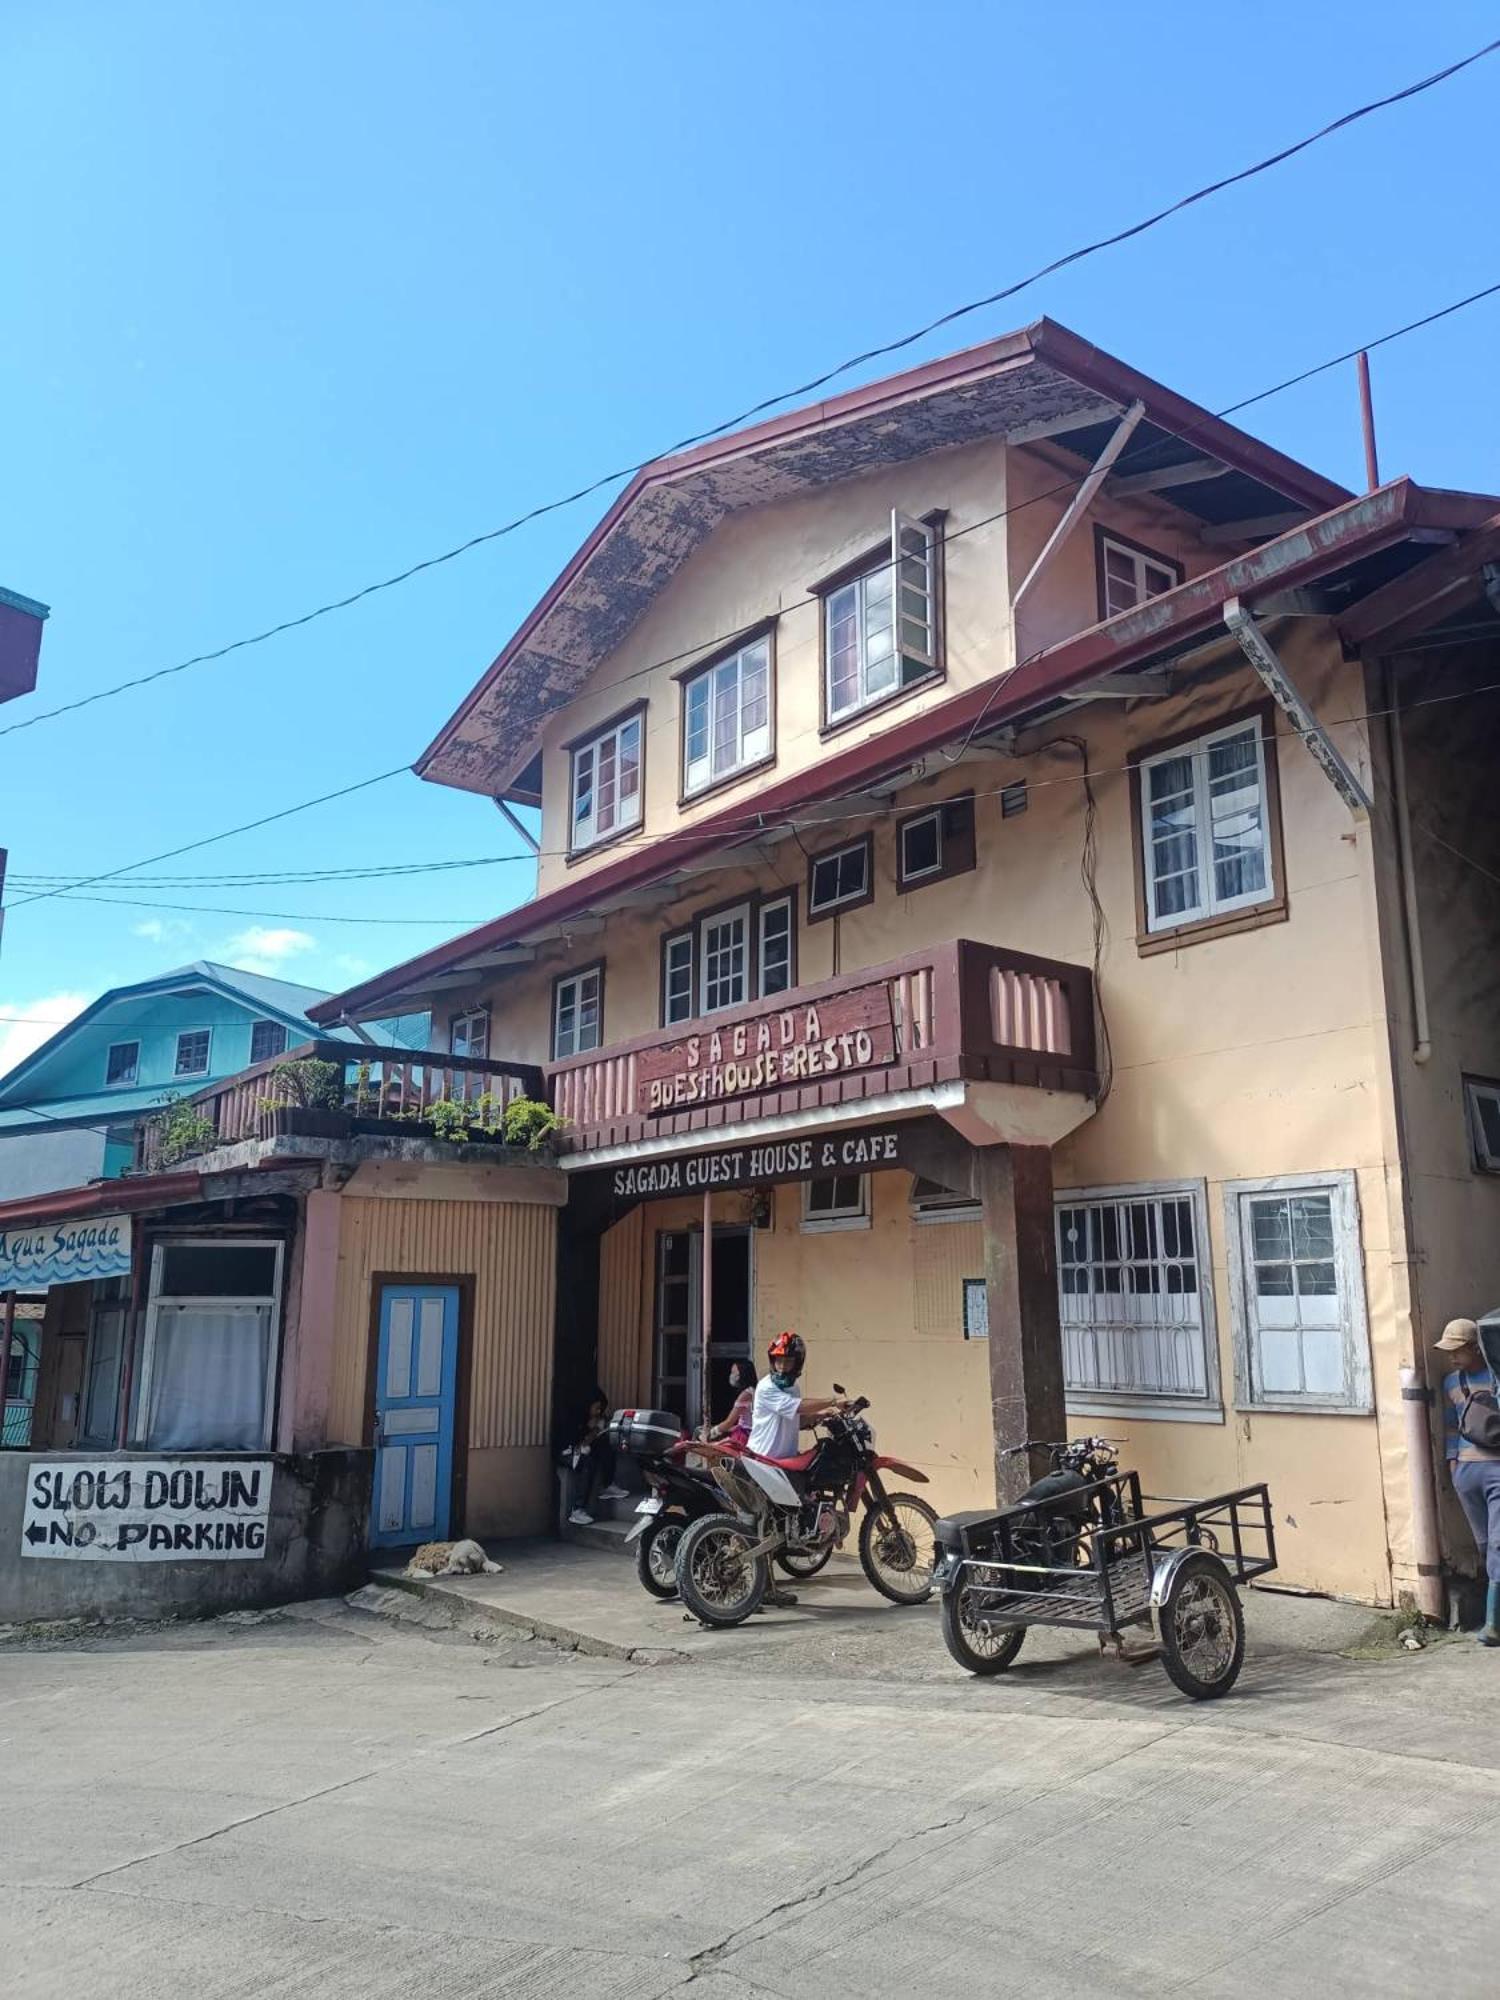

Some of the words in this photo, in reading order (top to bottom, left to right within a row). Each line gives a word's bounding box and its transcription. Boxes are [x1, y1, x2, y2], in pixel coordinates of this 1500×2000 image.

[687, 1006, 821, 1068] SAGADA
[614, 1162, 681, 1195] SAGADA
[686, 1152, 744, 1186] GUEST
[750, 1140, 813, 1177] HOUSE
[822, 1142, 837, 1167] &
[842, 1134, 899, 1165] CAFE
[31, 1470, 132, 1510] SLOW
[143, 1469, 261, 1510] DOWN
[50, 1521, 97, 1548] NO
[116, 1522, 266, 1551] PARKING
